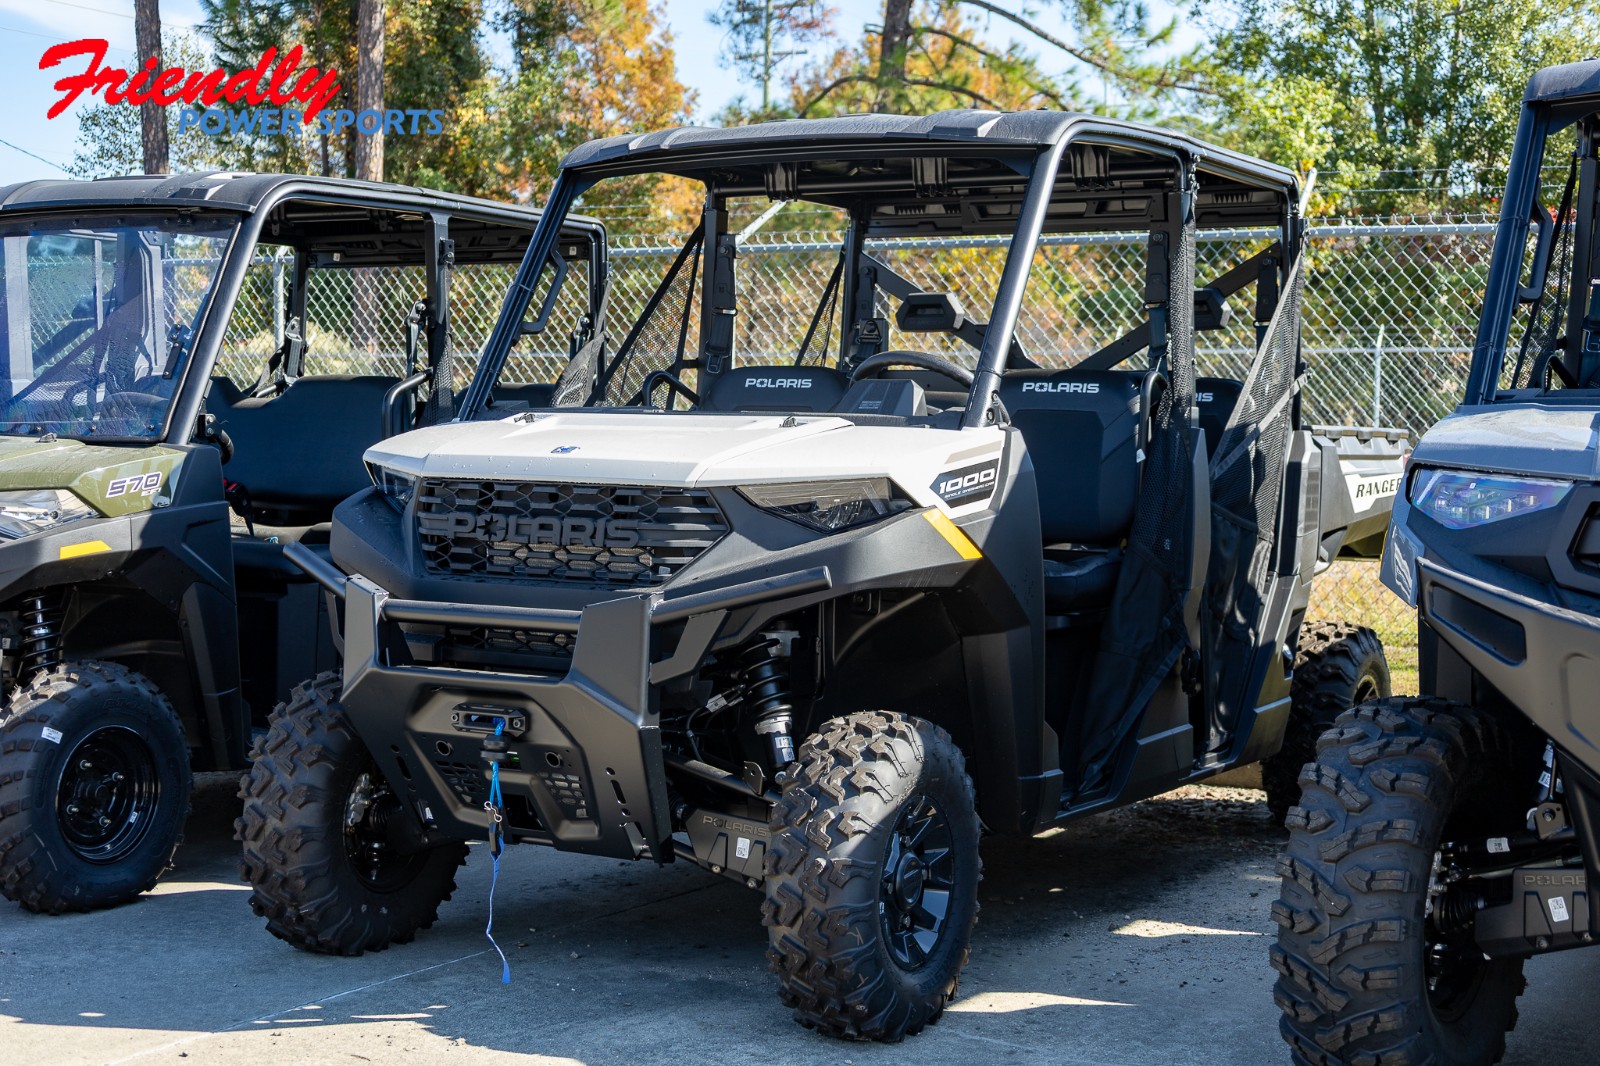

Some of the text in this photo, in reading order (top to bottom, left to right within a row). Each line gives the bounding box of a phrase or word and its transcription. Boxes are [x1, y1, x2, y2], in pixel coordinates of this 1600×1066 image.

[745, 378, 812, 389] POLARIS
[1022, 382, 1100, 394] POLARIS
[106, 472, 162, 498] 570
[939, 468, 996, 495] 1000
[449, 511, 642, 549] POLARIS
[702, 815, 768, 837] POLARIS
[1523, 874, 1586, 886] POLAR
